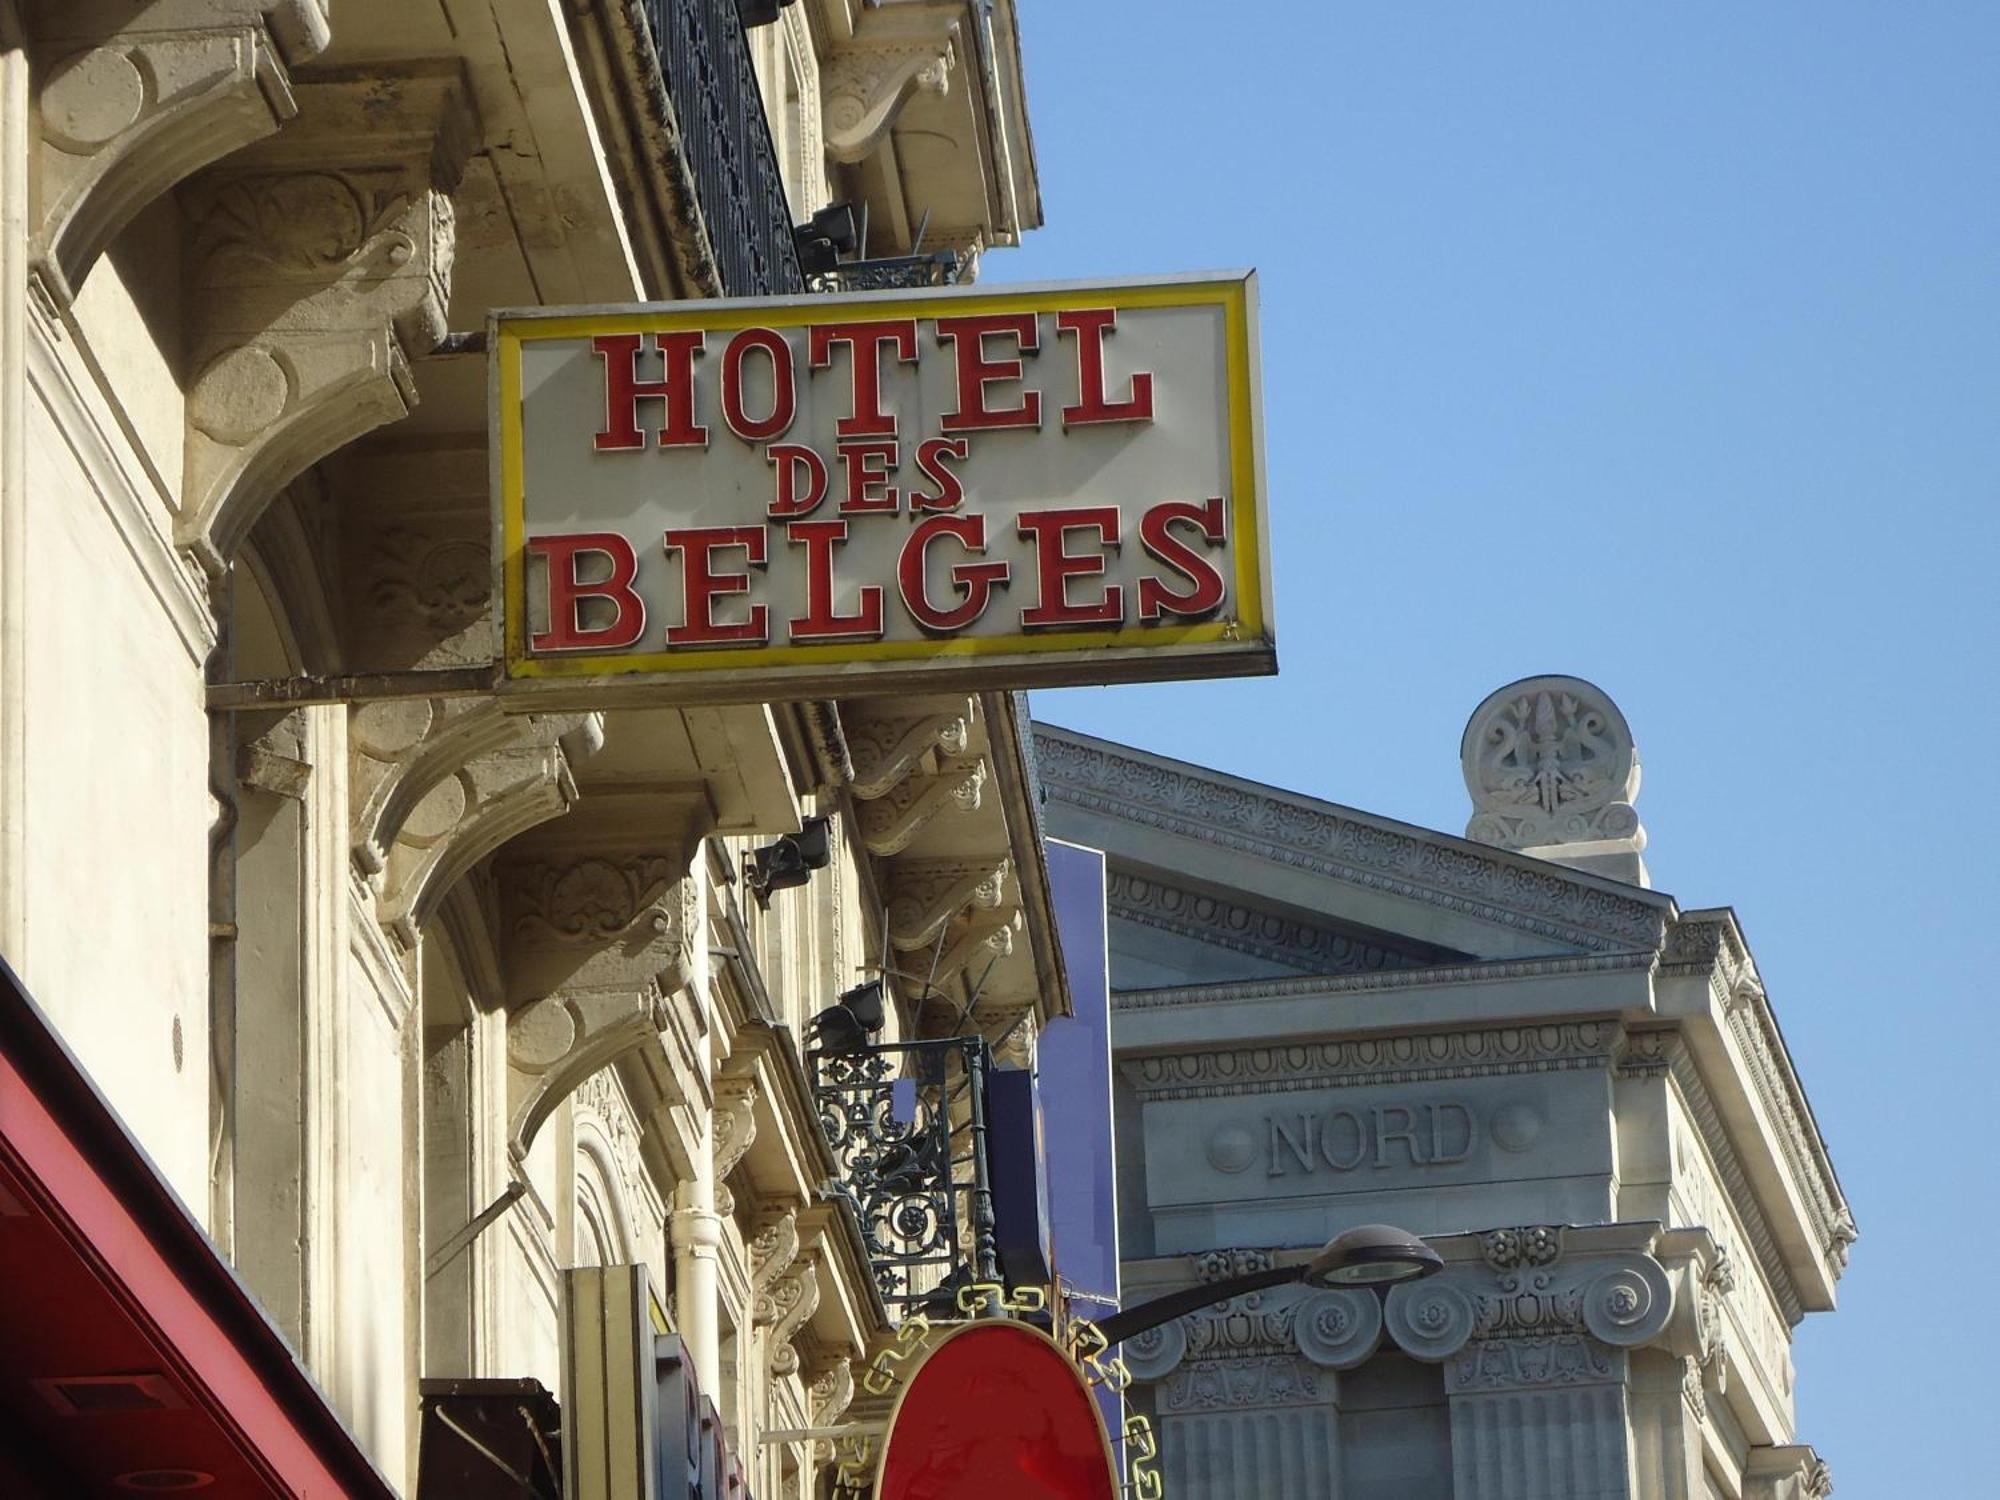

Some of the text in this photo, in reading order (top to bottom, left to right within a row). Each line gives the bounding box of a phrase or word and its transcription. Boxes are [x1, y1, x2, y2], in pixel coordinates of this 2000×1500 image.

[593, 308, 1154, 451] HOTEL
[765, 438, 969, 519] DES
[528, 497, 1227, 652] BELGES
[1265, 1102, 1476, 1177] NORD
